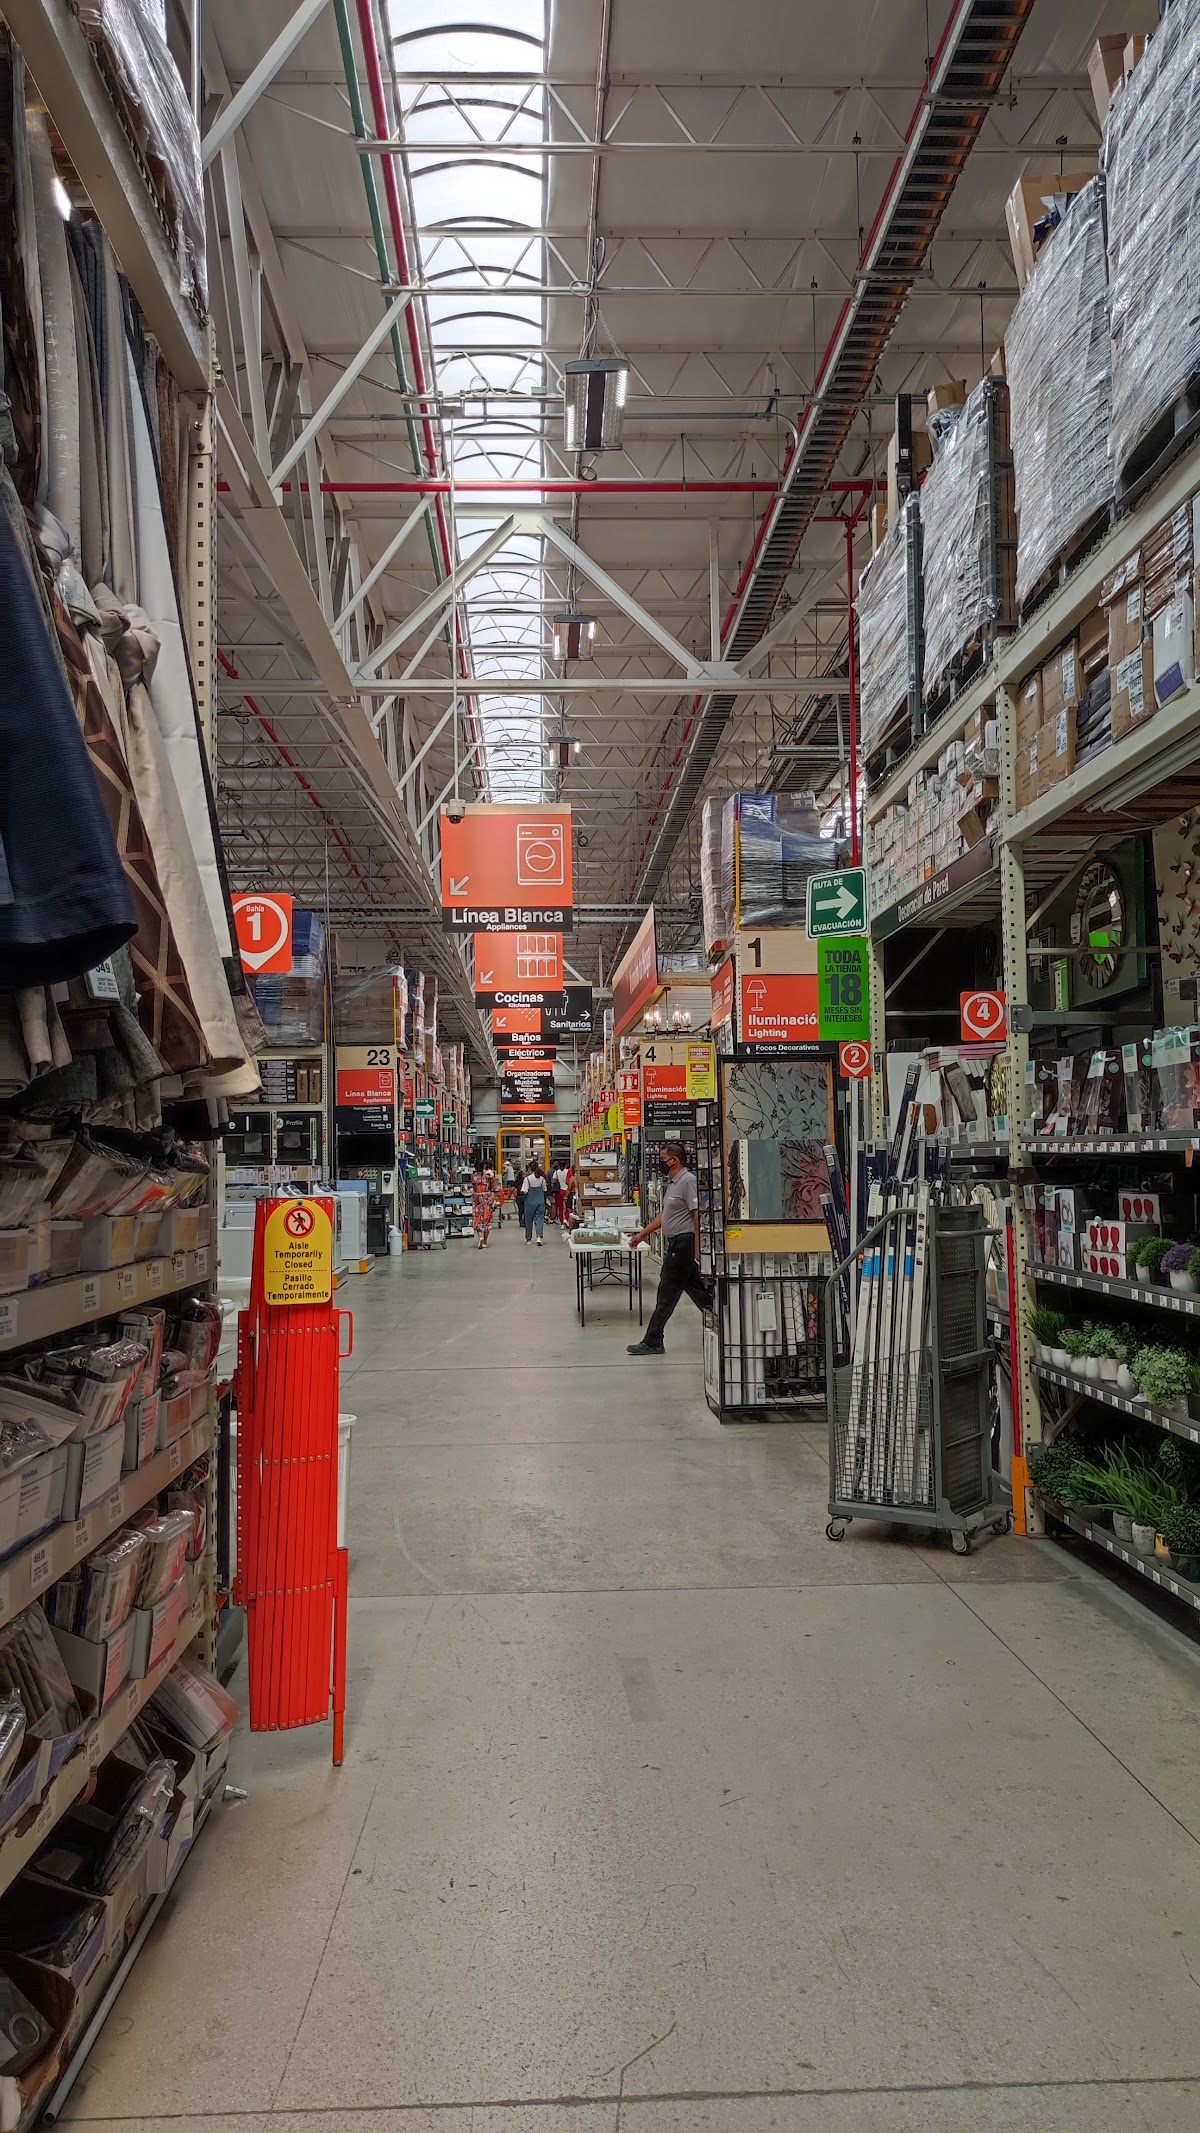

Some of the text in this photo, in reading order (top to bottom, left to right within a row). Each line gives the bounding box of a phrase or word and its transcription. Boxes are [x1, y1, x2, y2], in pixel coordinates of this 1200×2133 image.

[814, 878, 843, 890] RUTA DE
[924, 886, 932, 904] de
[932, 872, 949, 899] Pared
[452, 908, 564, 924] Línea Blanca
[246, 912, 261, 940] 1
[486, 923, 527, 932] Appliances
[812, 918, 862, 932] EVACUACIÓN
[748, 938, 762, 967] 1
[824, 950, 862, 964] TODA
[824, 974, 863, 1006] 18
[494, 992, 544, 1002] Cocinas
[824, 1006, 862, 1014] MESES SIN
[976, 1002, 990, 1020] 4
[550, 1020, 591, 1028] Sanitarios
[748, 1013, 819, 1026] Iluminació
[512, 1033, 541, 1042] Baños
[748, 1028, 787, 1038] Lighting
[367, 1049, 390, 1066] 23
[645, 1046, 657, 1062] 4
[850, 1050, 860, 1063] 2
[288, 1242, 309, 1250] Aisle
[274, 1250, 322, 1259] Temporarily
[284, 1260, 312, 1268] Closed
[284, 1274, 312, 1282] Pasillo
[282, 1282, 314, 1290] Cerrado
[268, 1290, 329, 1300] Temporalmente
